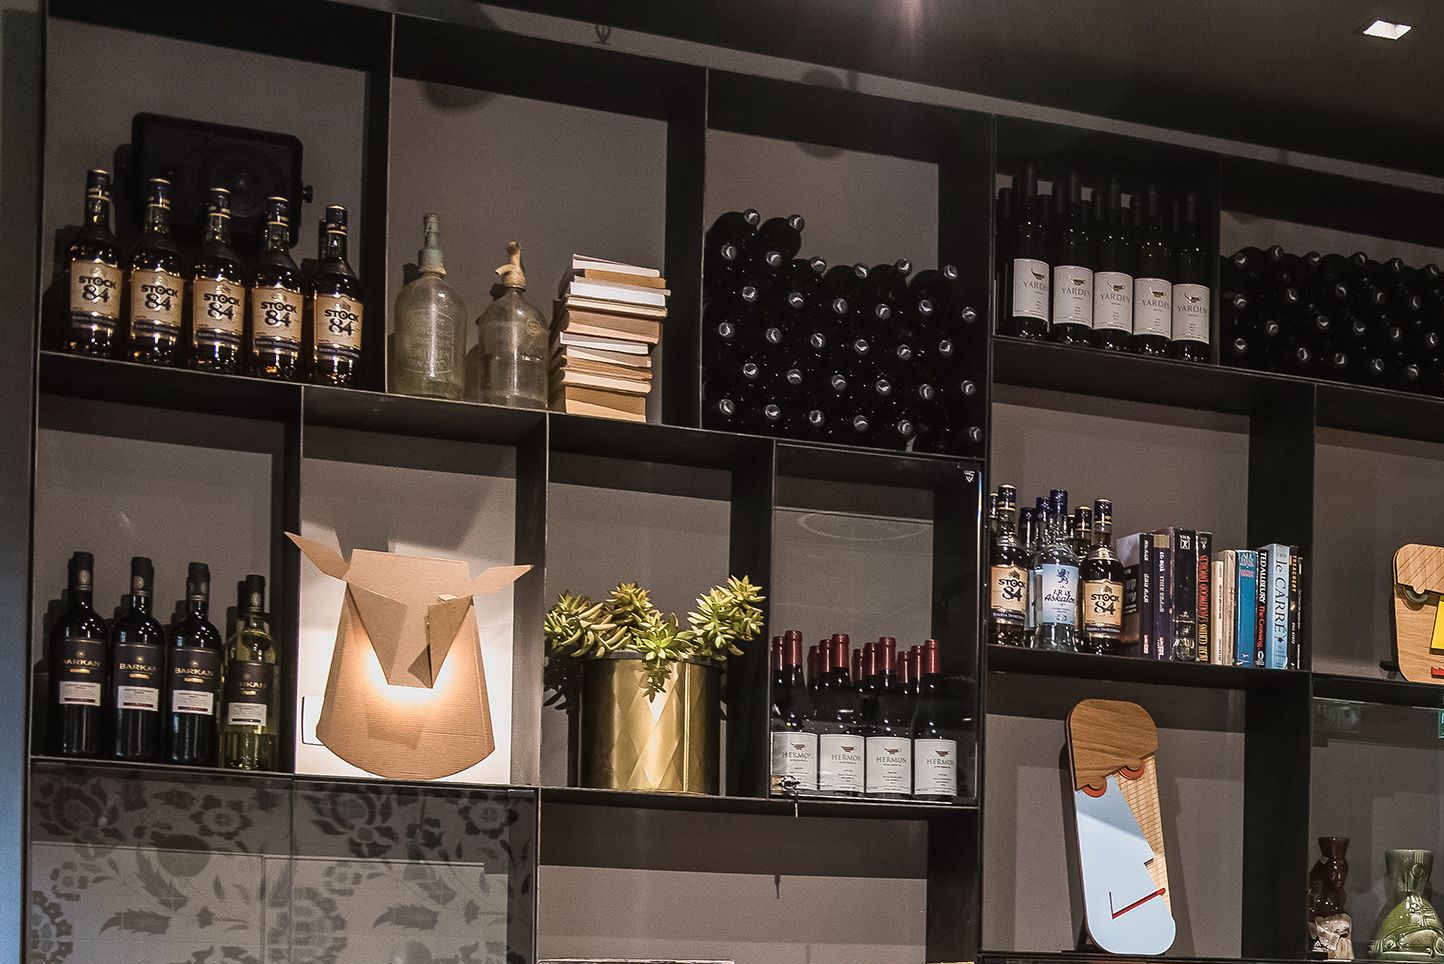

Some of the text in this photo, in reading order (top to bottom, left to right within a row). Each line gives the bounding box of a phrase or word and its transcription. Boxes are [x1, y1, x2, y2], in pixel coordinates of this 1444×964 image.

[78, 275, 117, 289] STOCK
[82, 284, 111, 304] 84
[141, 284, 179, 298] STOCK
[145, 293, 172, 312] 84
[203, 293, 240, 306] STOCK
[207, 301, 234, 320] 84
[260, 301, 298, 314] STOCK
[264, 309, 292, 328] 84
[324, 309, 359, 322] STOCK
[328, 318, 354, 336] 84
[1276, 560, 1287, 573] le
[1002, 586, 1022, 602] 84
[1044, 593, 1076, 604] Askalo
[1090, 593, 1120, 603] STOCK
[1094, 600, 1116, 615] 84
[831, 754, 862, 762] HERMON
[876, 756, 908, 765] HERMON
